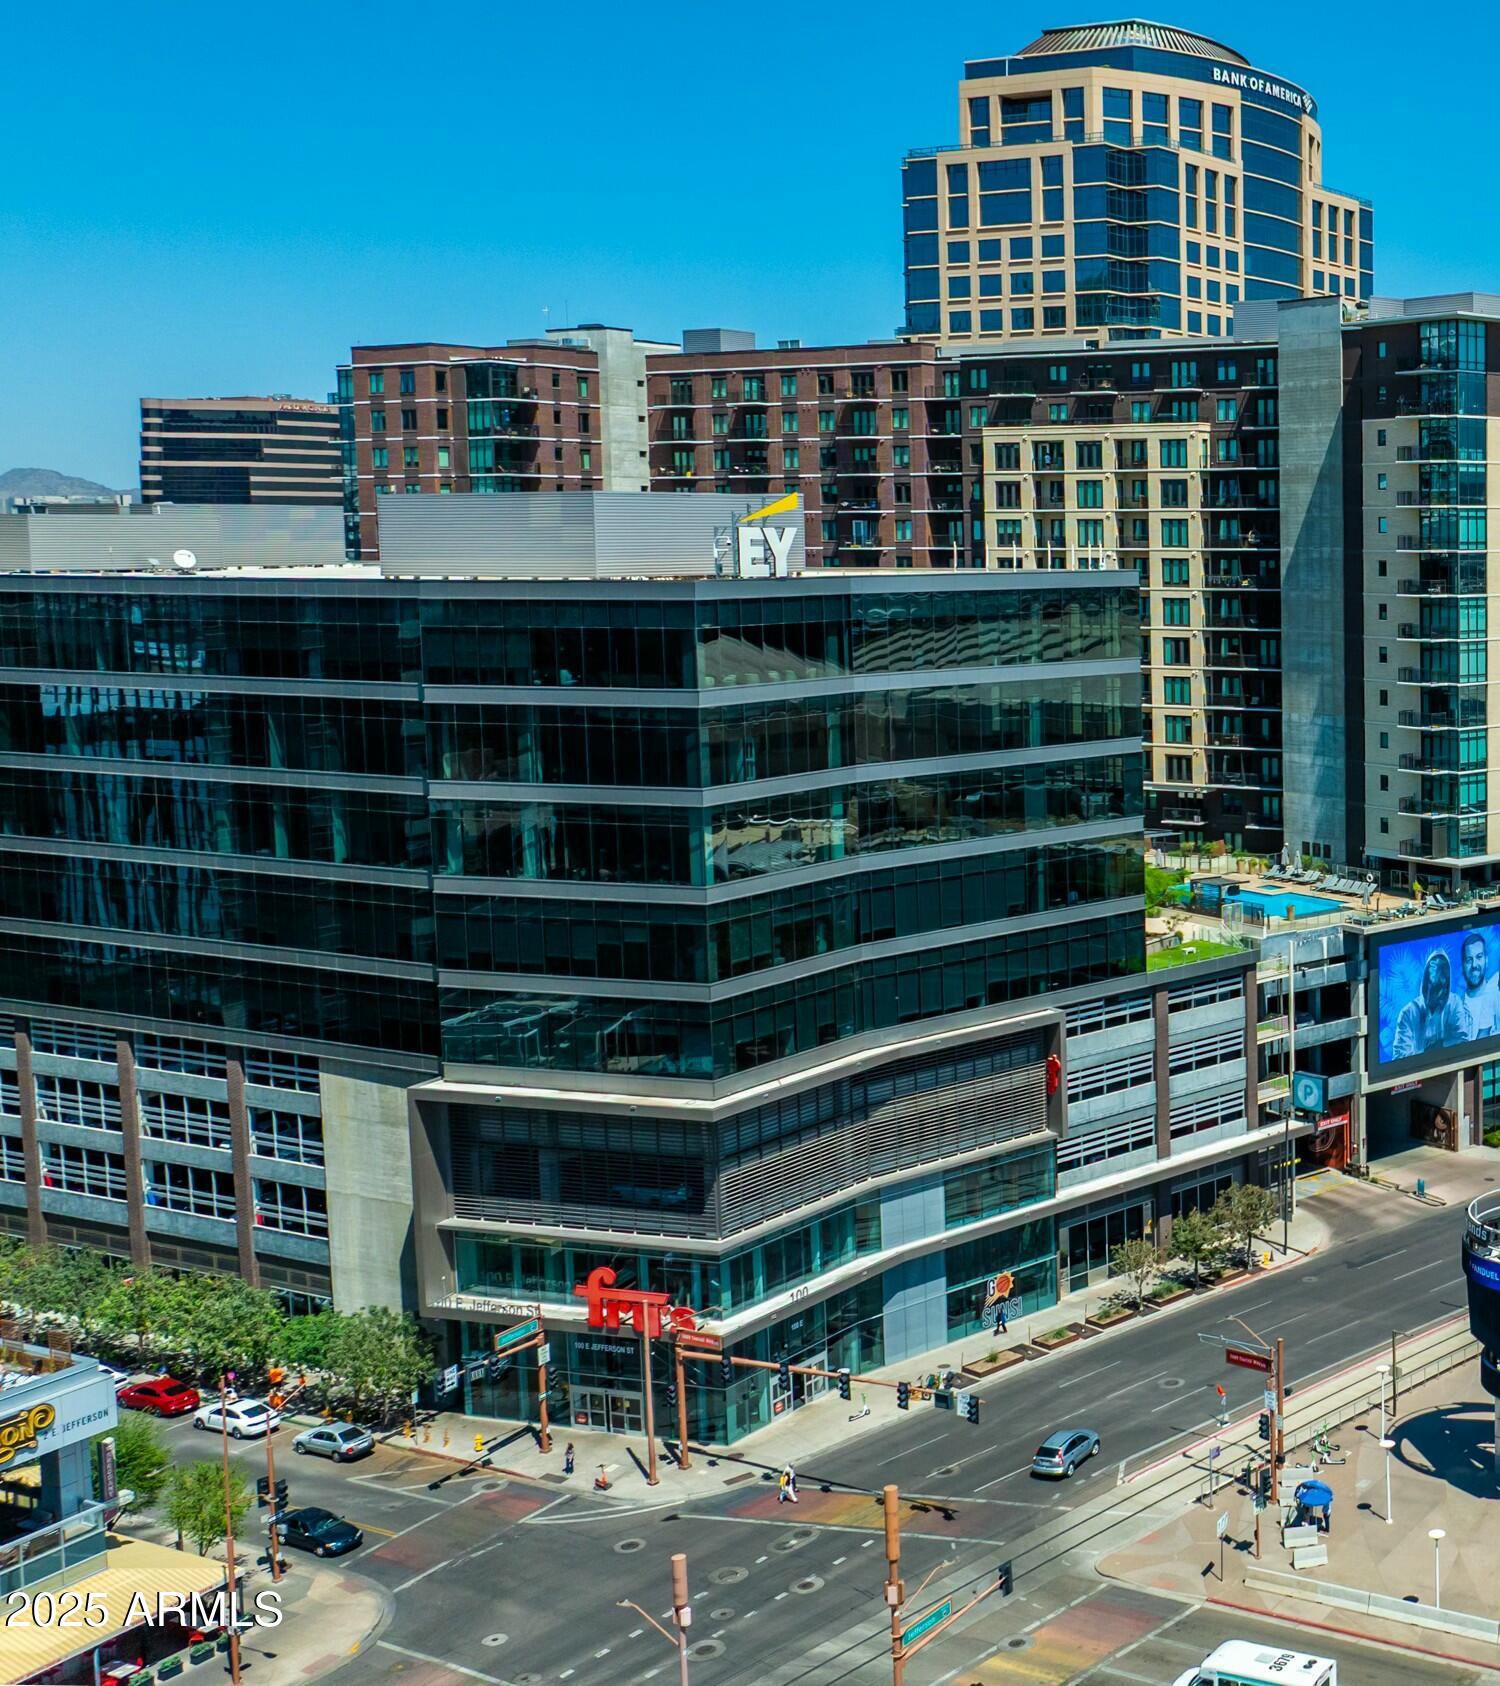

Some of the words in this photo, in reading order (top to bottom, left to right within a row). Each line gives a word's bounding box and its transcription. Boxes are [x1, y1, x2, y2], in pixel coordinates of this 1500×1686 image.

[1213, 67, 1247, 88] BANK
[1249, 77, 1265, 92] OF
[1265, 82, 1302, 108] AMERICA
[737, 526, 798, 577] EY
[1303, 1084, 1314, 1101] P
[790, 1286, 809, 1302] 100
[575, 1342, 585, 1350] 100
[591, 1343, 625, 1353] JEFFERSON
[626, 1346, 634, 1354] ST
[62, 1408, 109, 1433] JEFFERSON
